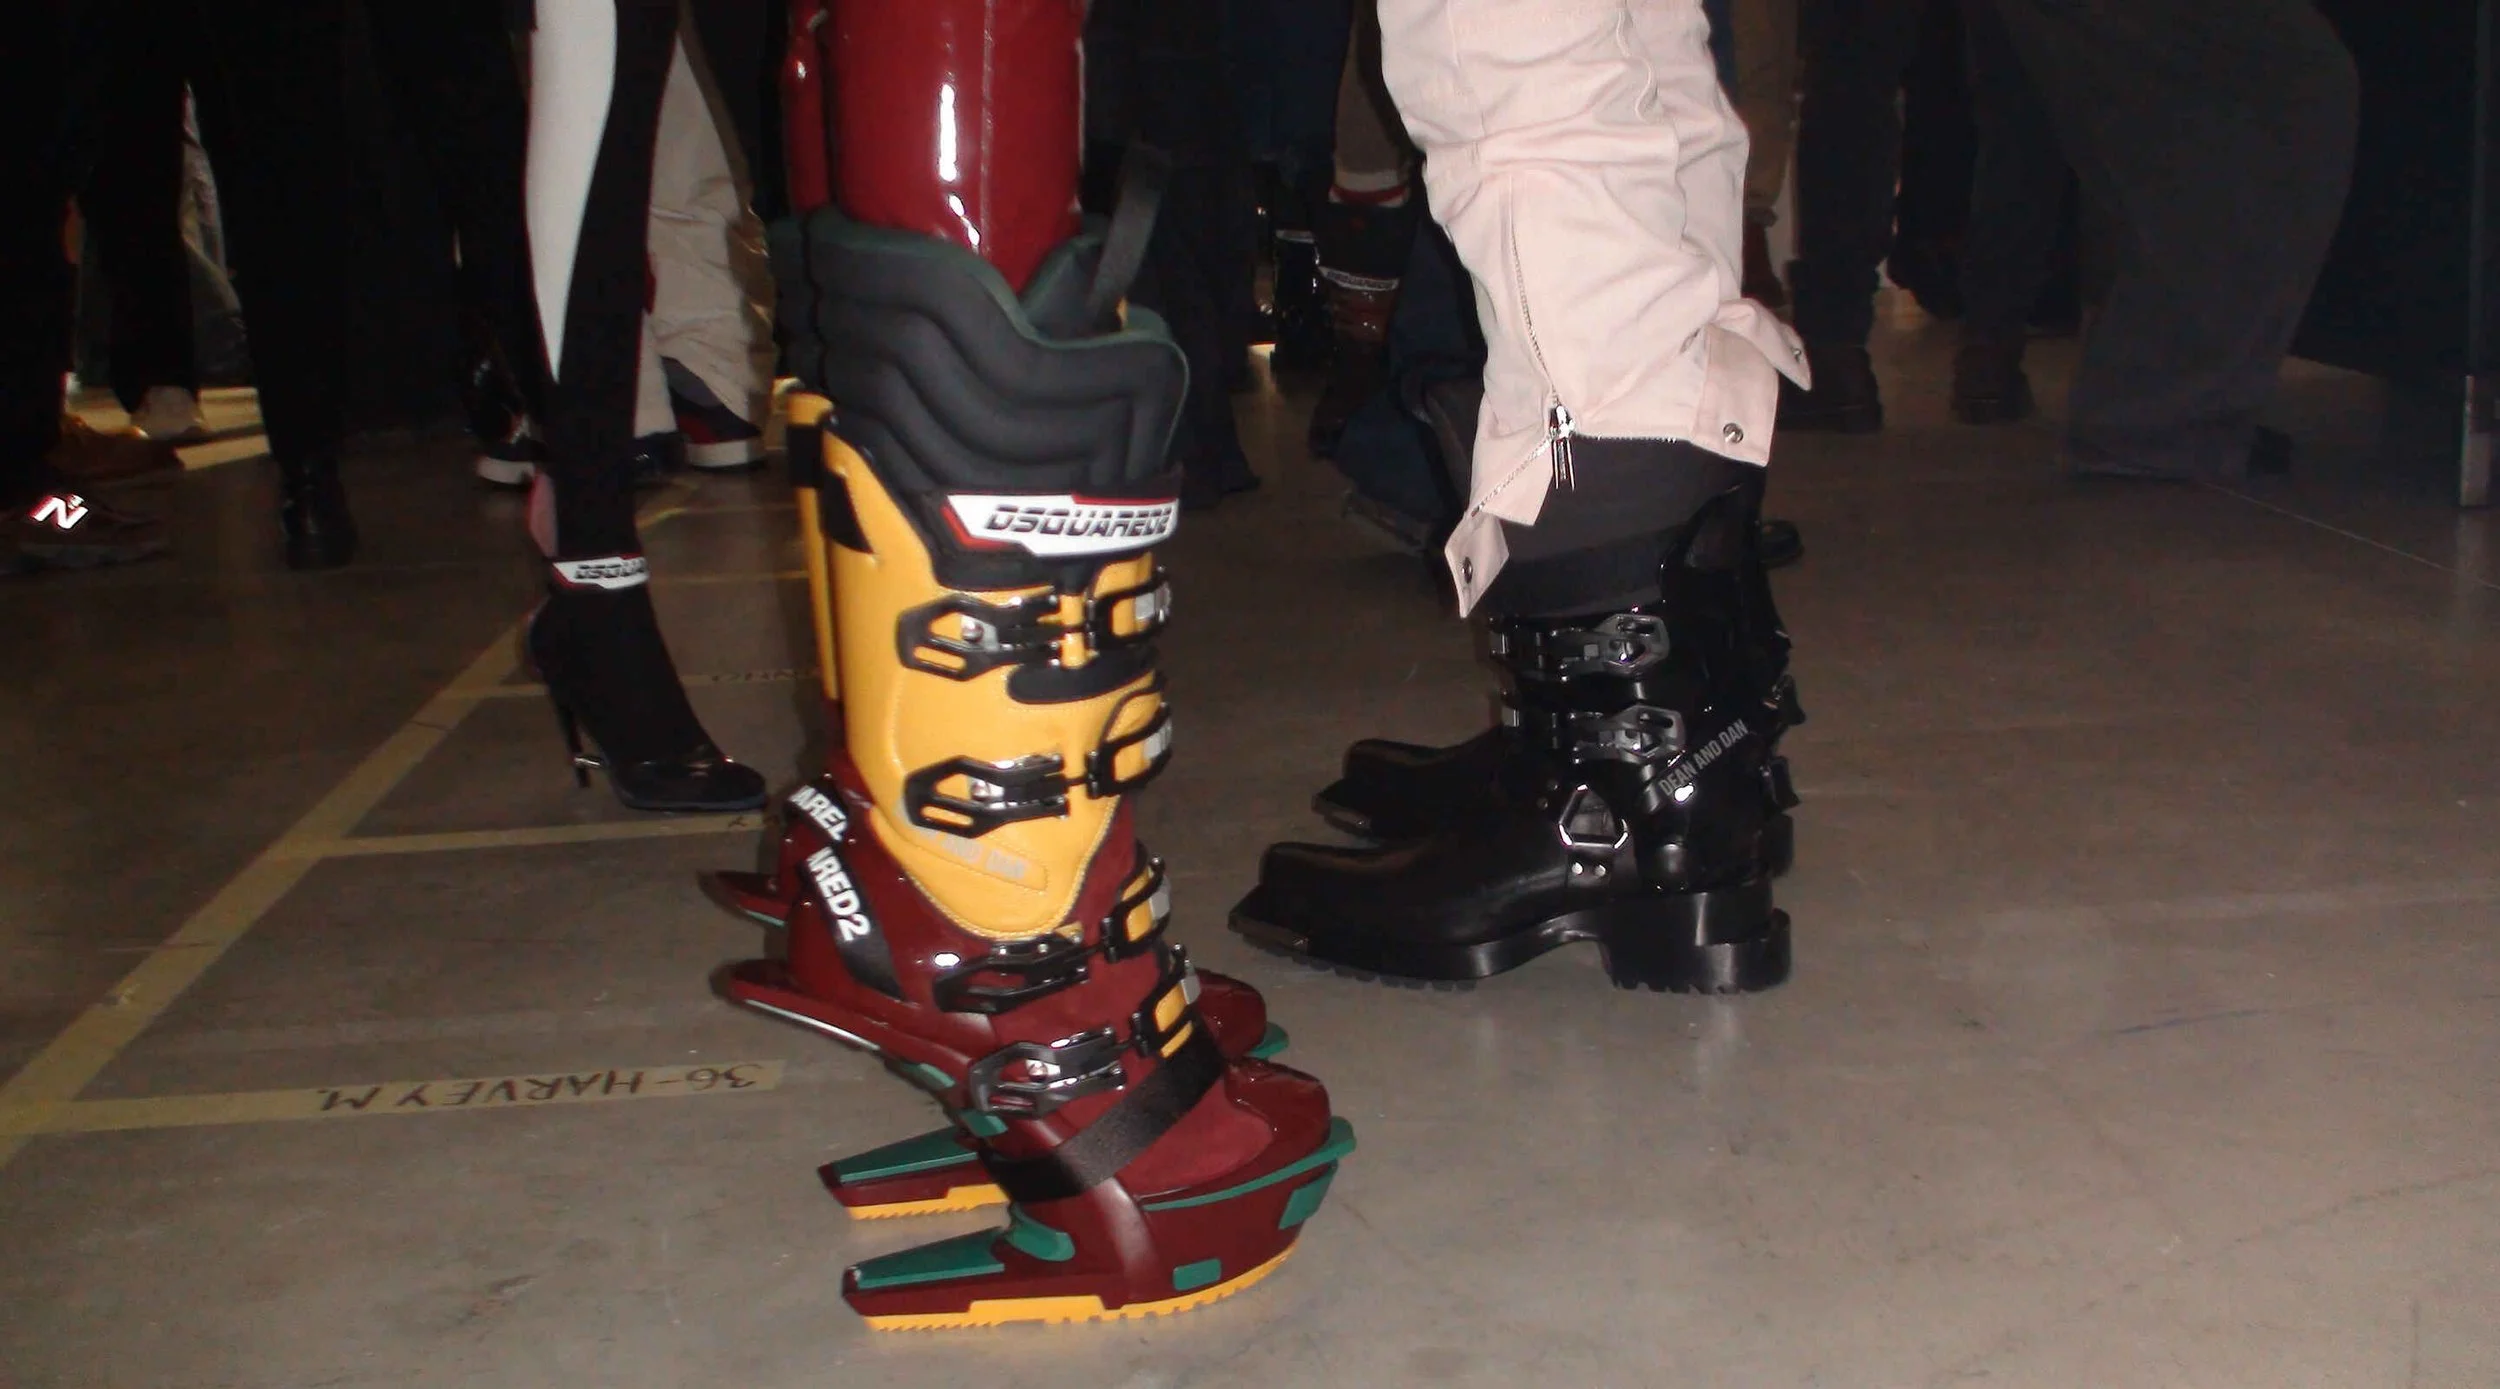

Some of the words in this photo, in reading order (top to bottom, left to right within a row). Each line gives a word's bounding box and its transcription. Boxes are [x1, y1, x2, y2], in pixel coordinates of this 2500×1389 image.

[1658, 760, 1698, 796] DEAN
[1693, 740, 1722, 770] AND
[1718, 718, 1749, 749] DAN
